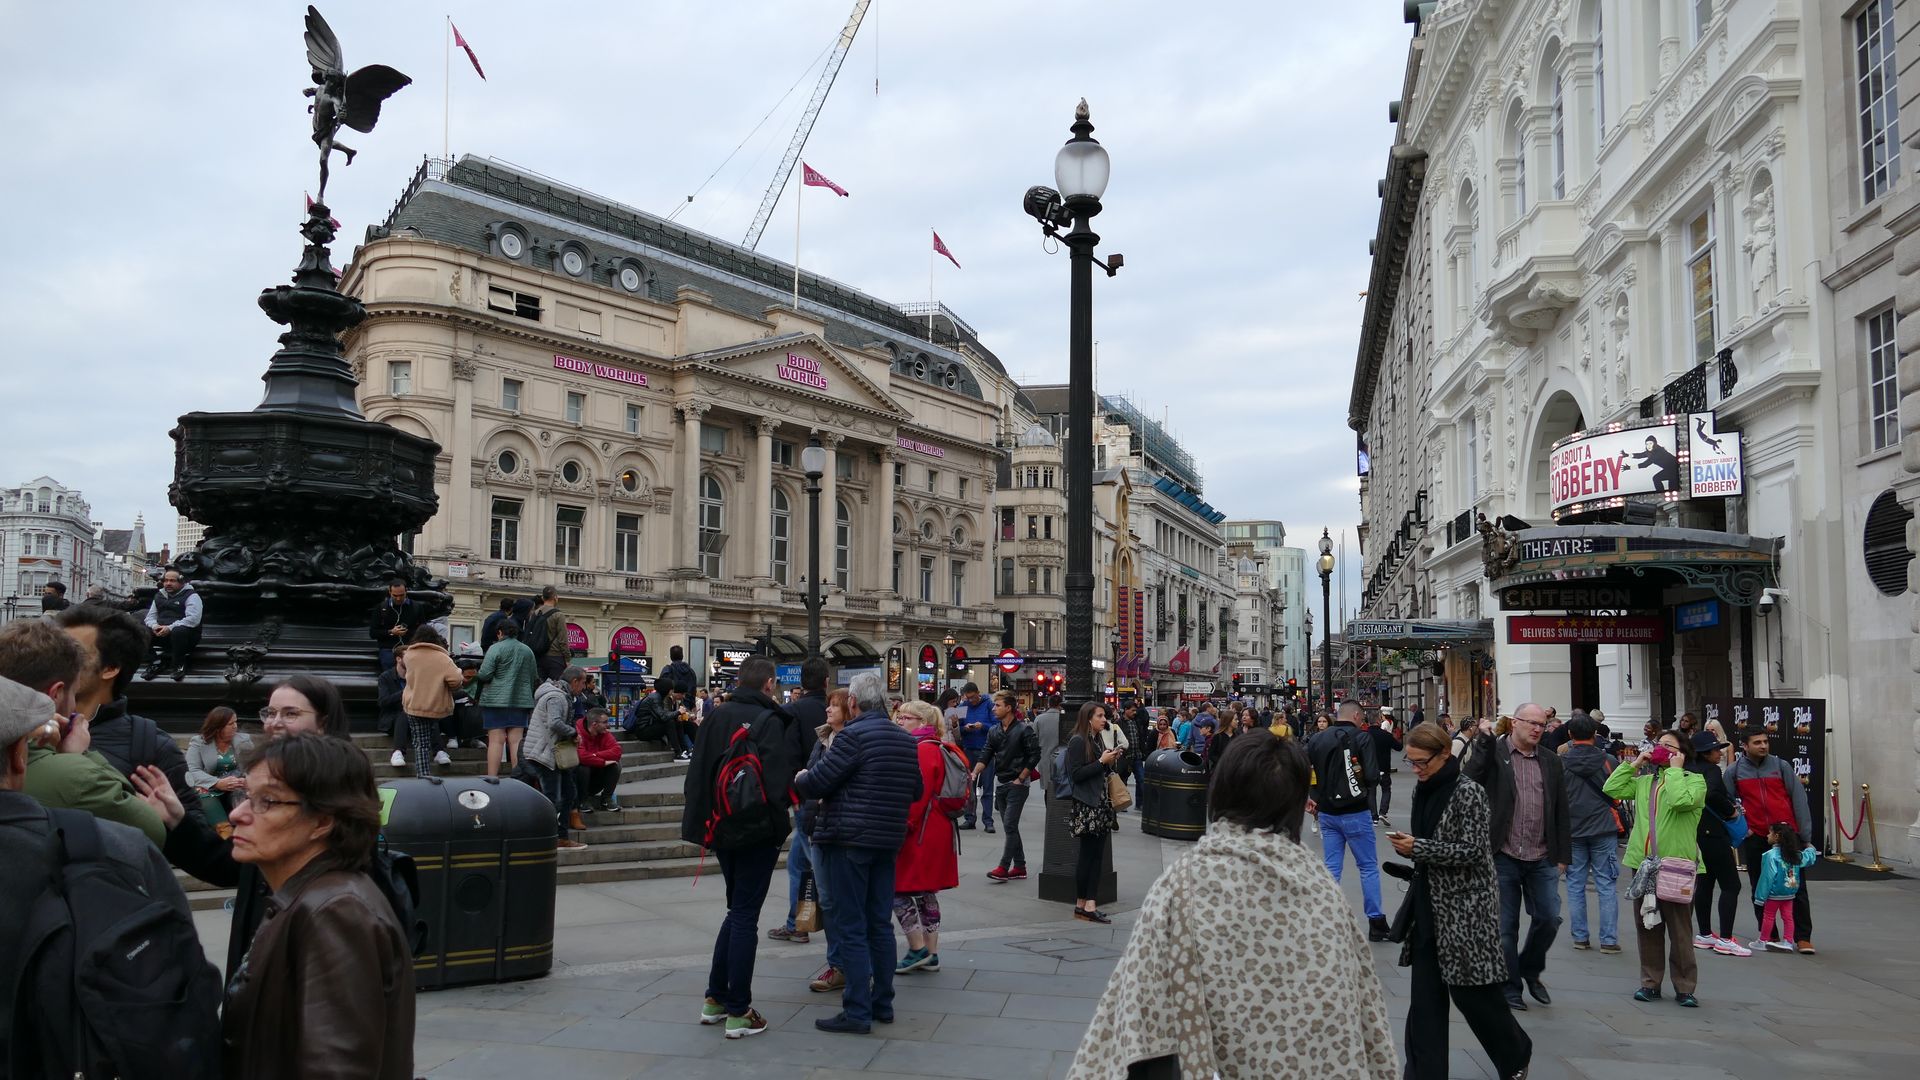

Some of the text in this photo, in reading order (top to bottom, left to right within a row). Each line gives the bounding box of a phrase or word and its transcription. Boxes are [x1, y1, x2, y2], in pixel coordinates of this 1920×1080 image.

[555, 355, 648, 385] BODY WORLDS
[788, 353, 821, 372] BODY
[778, 364, 828, 389] WORLDS
[915, 442, 944, 457] WORLDS
[1562, 446, 1583, 465] ABOUT
[1585, 444, 1591, 459] A
[1694, 463, 1737, 482] BANK
[1694, 480, 1738, 493] ROBBERY
[1523, 539, 1593, 558] THEATRE
[1504, 589, 1631, 606] CRITERION
[1359, 625, 1402, 634] RESTAURANT
[1558, 628, 1603, 638] SWAG-LOADS
[1605, 628, 1614, 638] OF
[723, 651, 750, 659] TOBACCO
[1762, 706, 1779, 727] Black
[1792, 706, 1812, 728] Black
